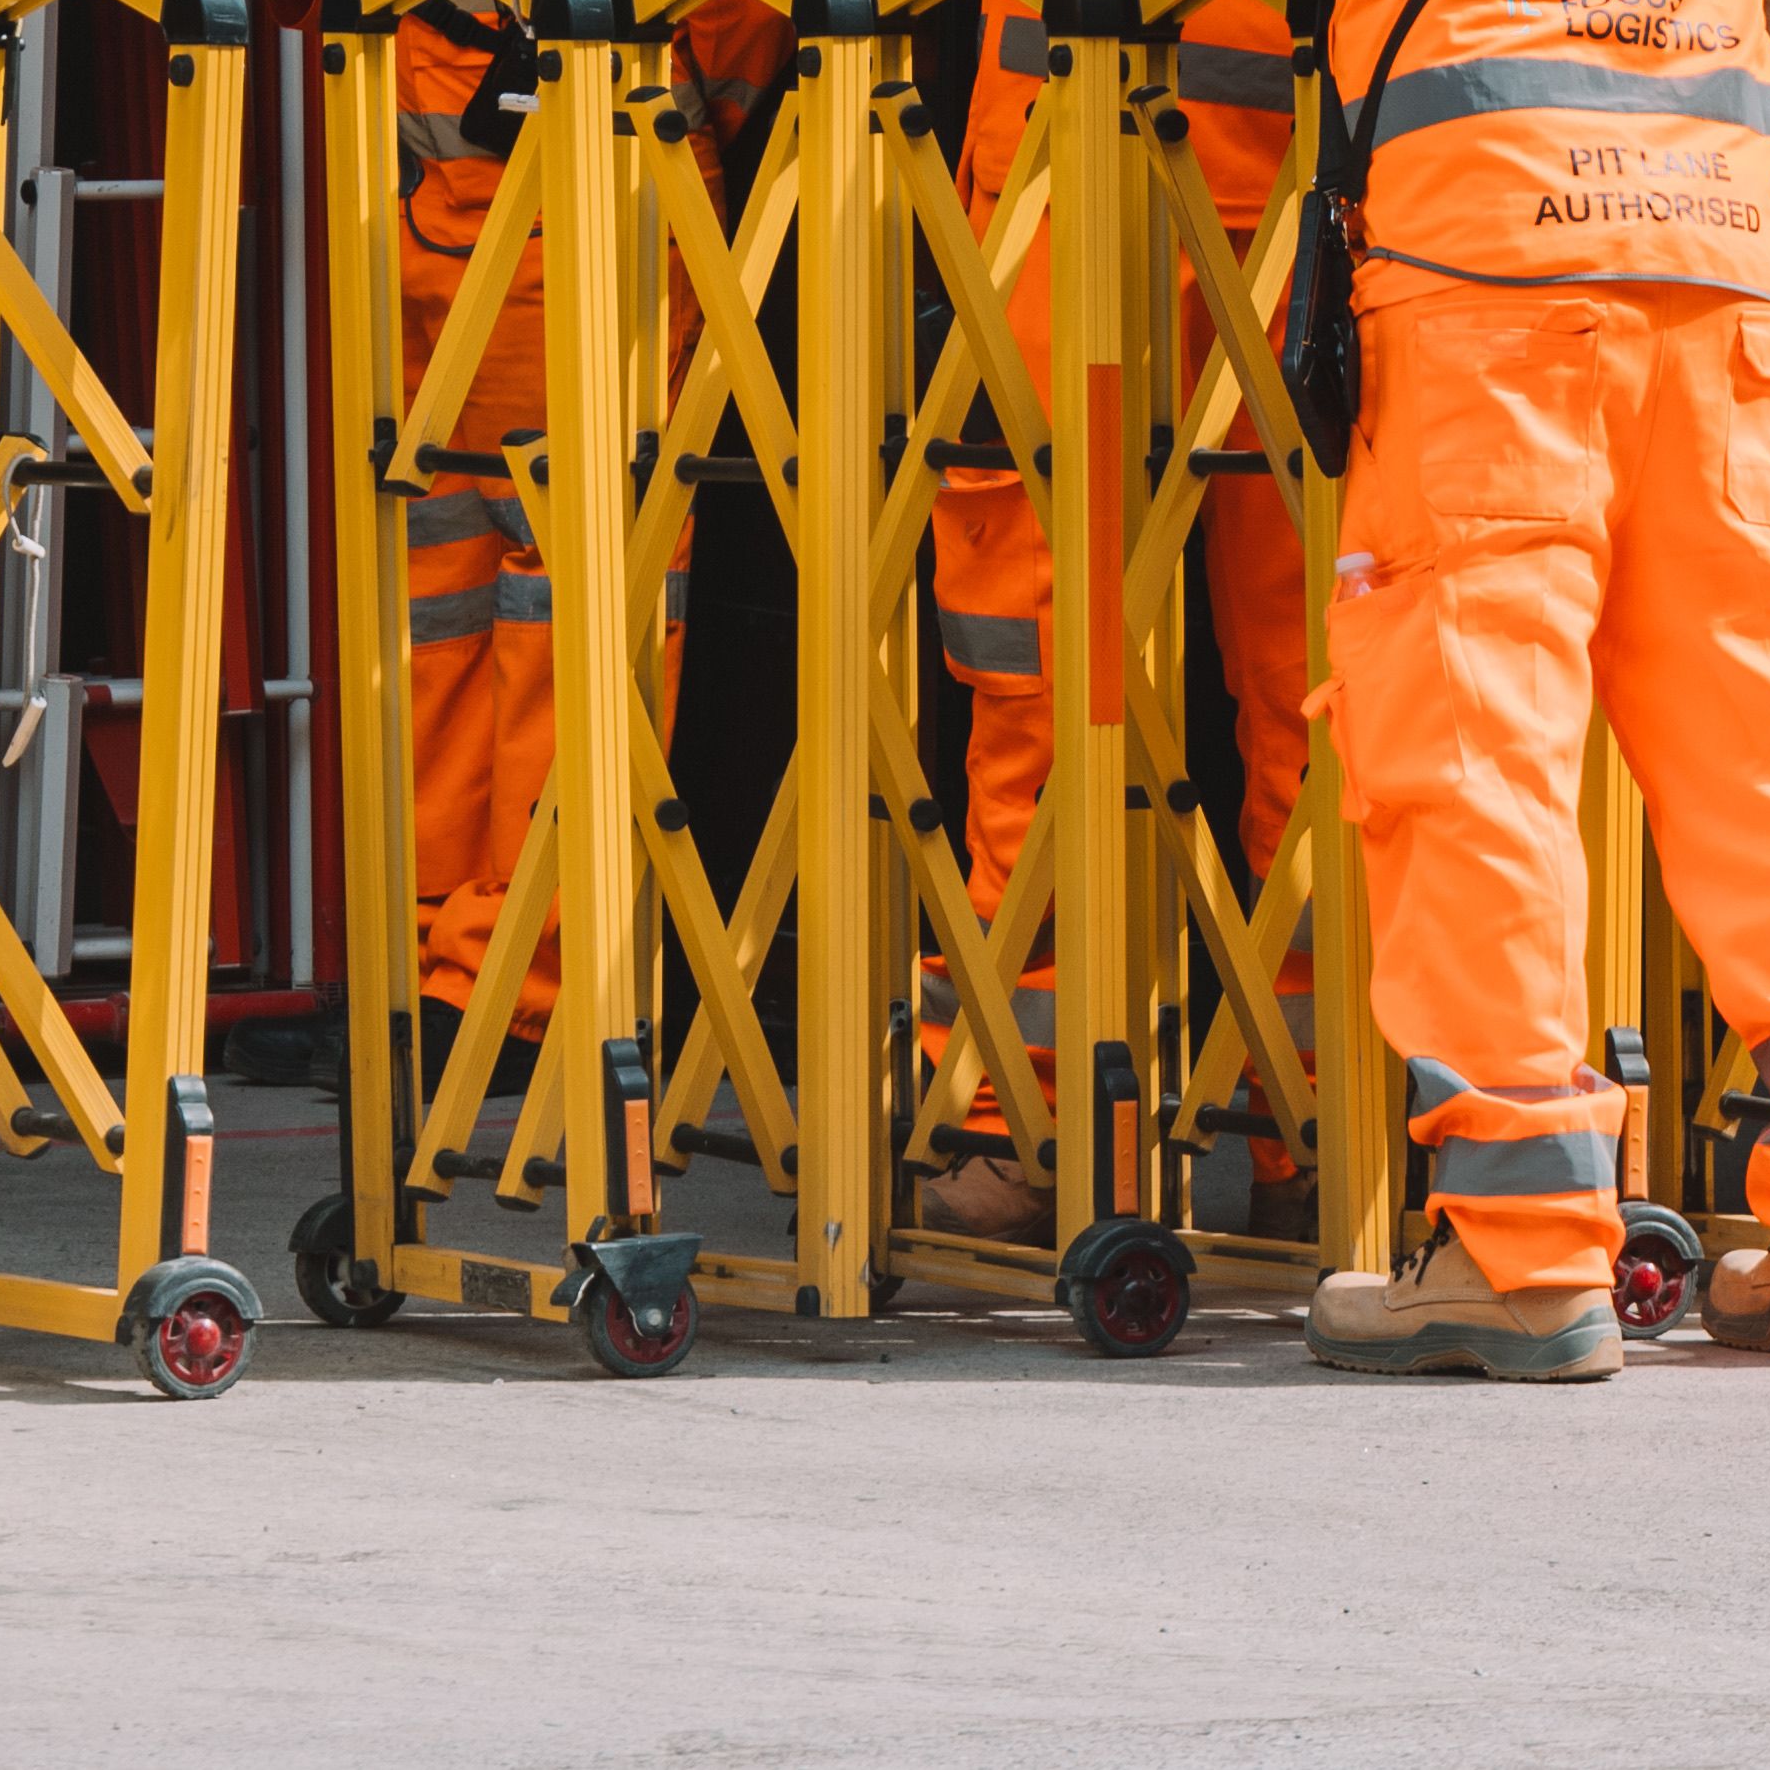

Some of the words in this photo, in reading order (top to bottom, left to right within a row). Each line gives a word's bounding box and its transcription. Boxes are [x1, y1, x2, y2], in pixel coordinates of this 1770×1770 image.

[1566, 9, 1741, 52] LOGISTICS
[1569, 147, 1628, 176] PIT
[1640, 150, 1732, 182] LANE
[1535, 192, 1761, 234] AUTHORISED
